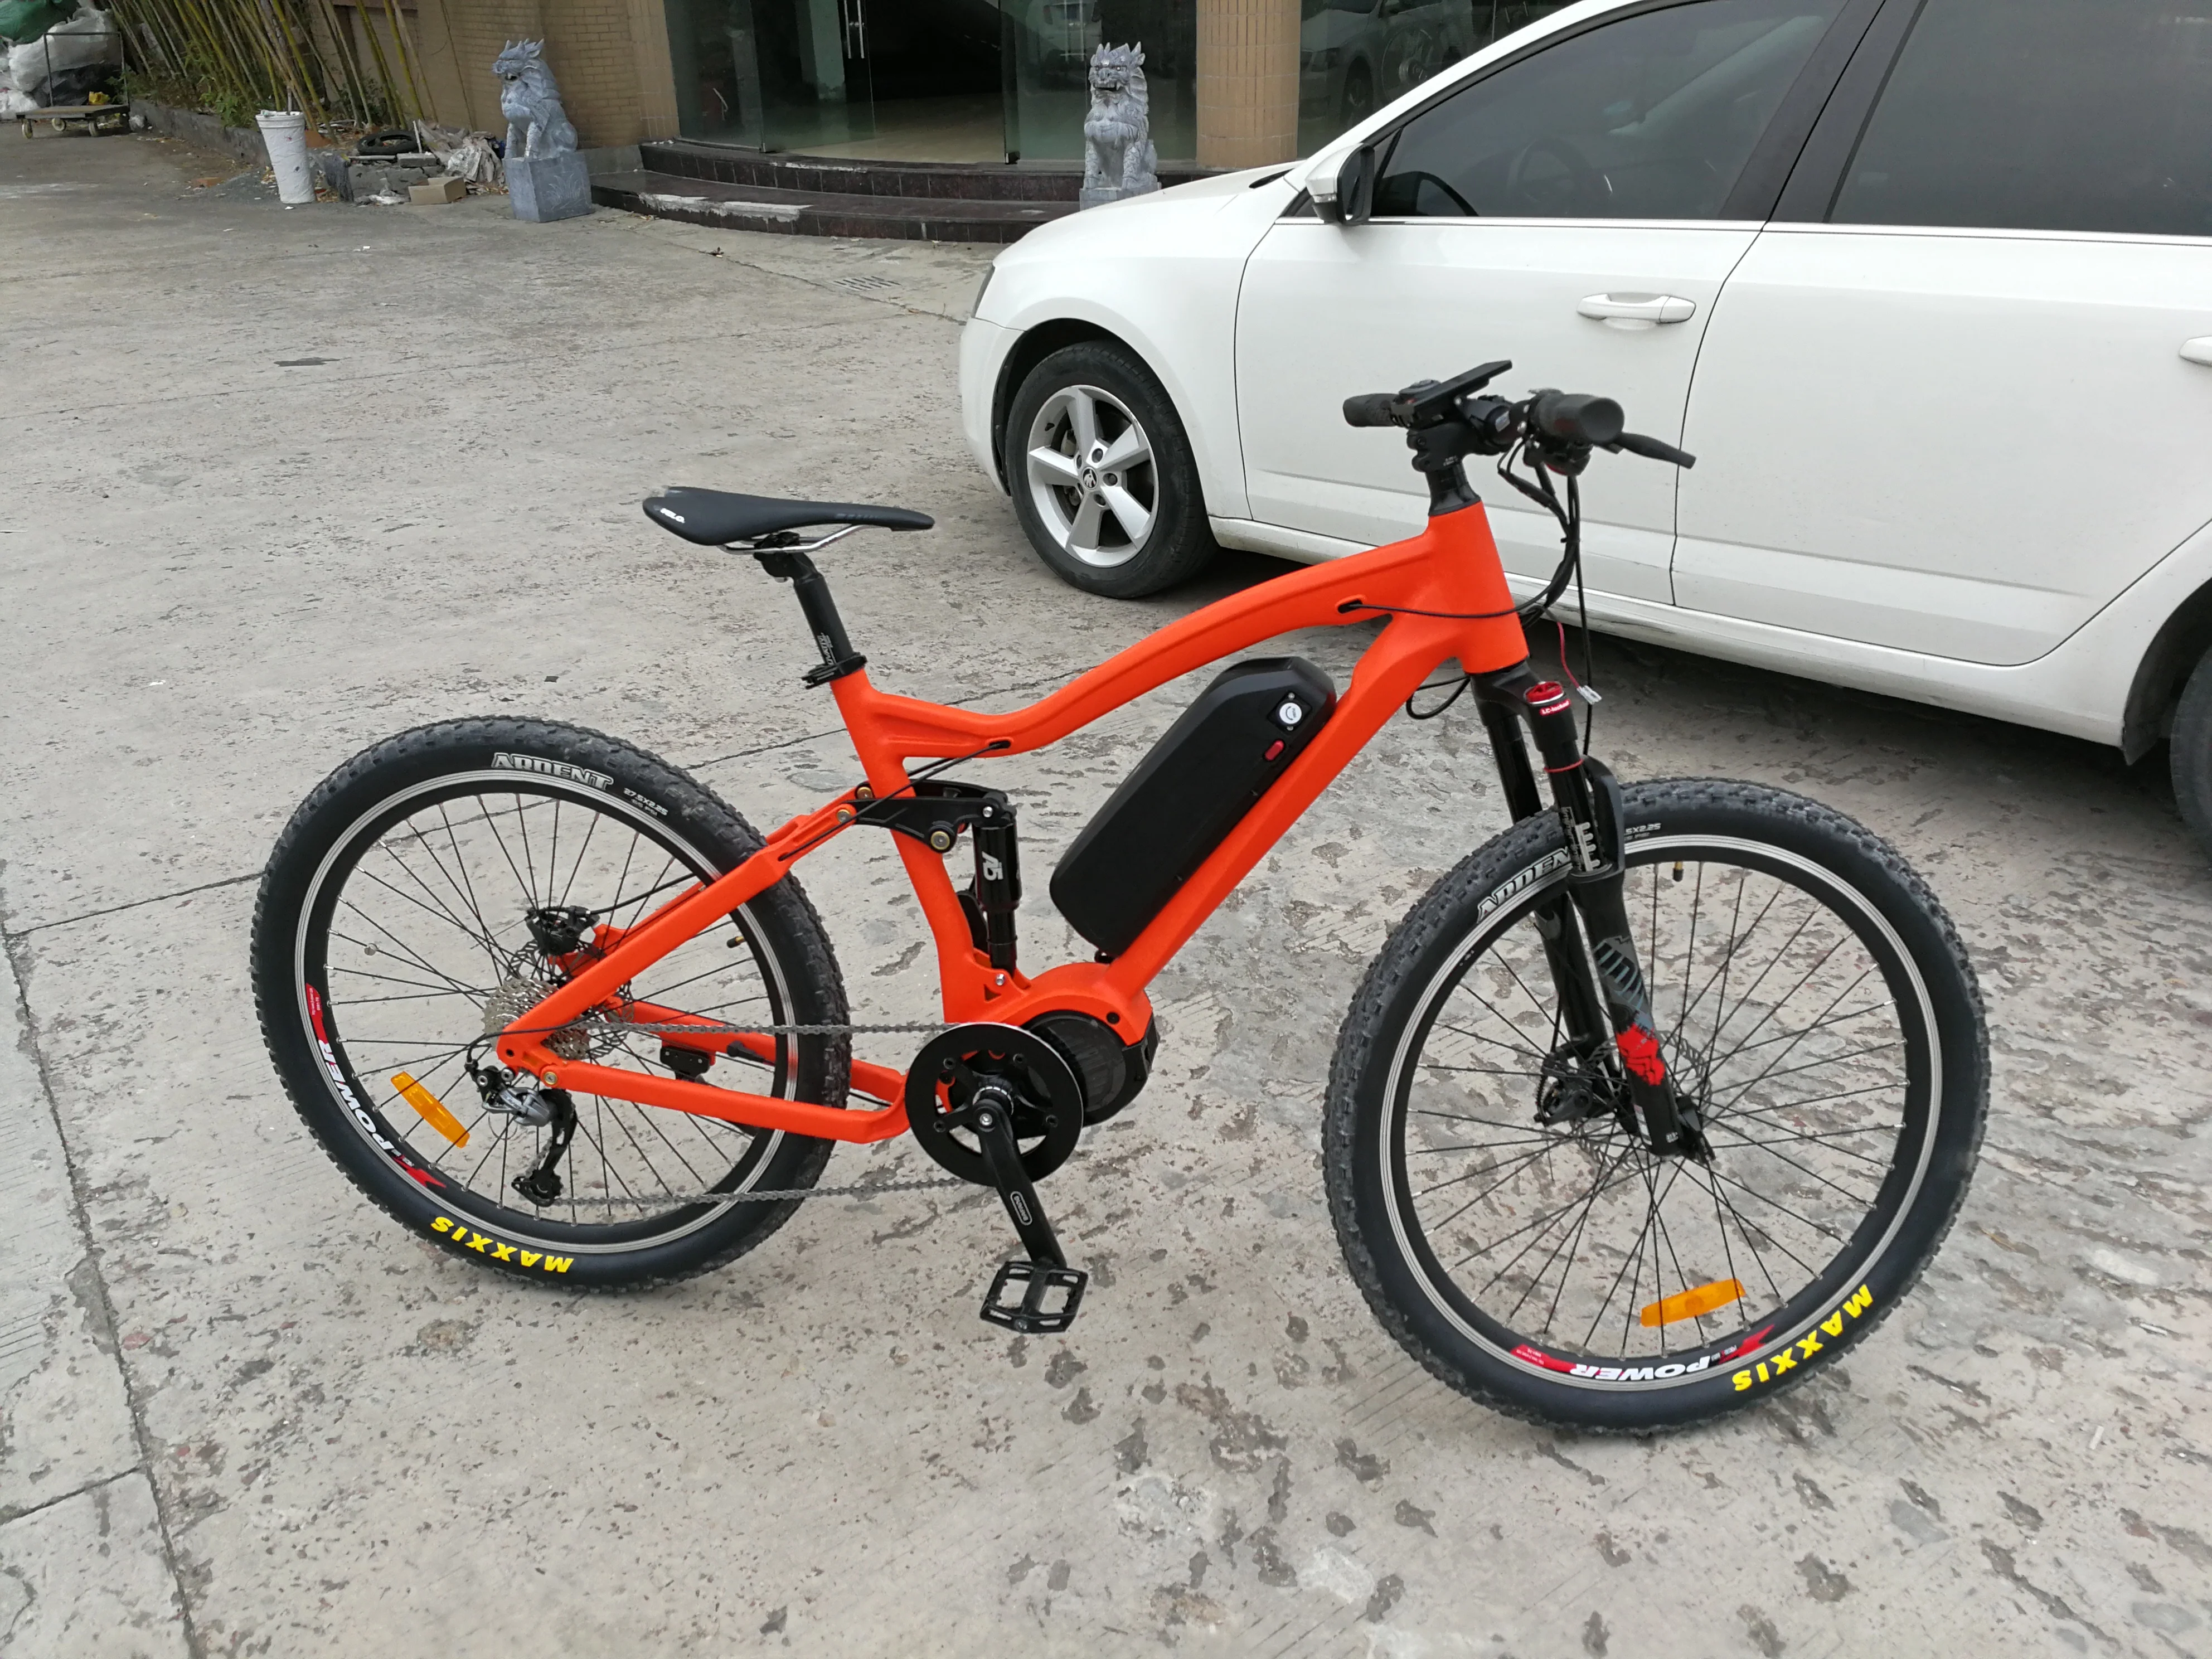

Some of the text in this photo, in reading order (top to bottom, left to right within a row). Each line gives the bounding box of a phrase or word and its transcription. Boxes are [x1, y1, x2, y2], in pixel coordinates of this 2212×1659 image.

[492, 753, 614, 790] ARDENT
[1624, 823, 1661, 836] .5X2.25
[1477, 846, 1572, 920] ARDEN
[318, 1040, 395, 1150] POWER
[431, 1217, 574, 1273] MAXXIS
[1732, 1284, 1874, 1391] MAXXIS
[1570, 1356, 1711, 1381] POWER
